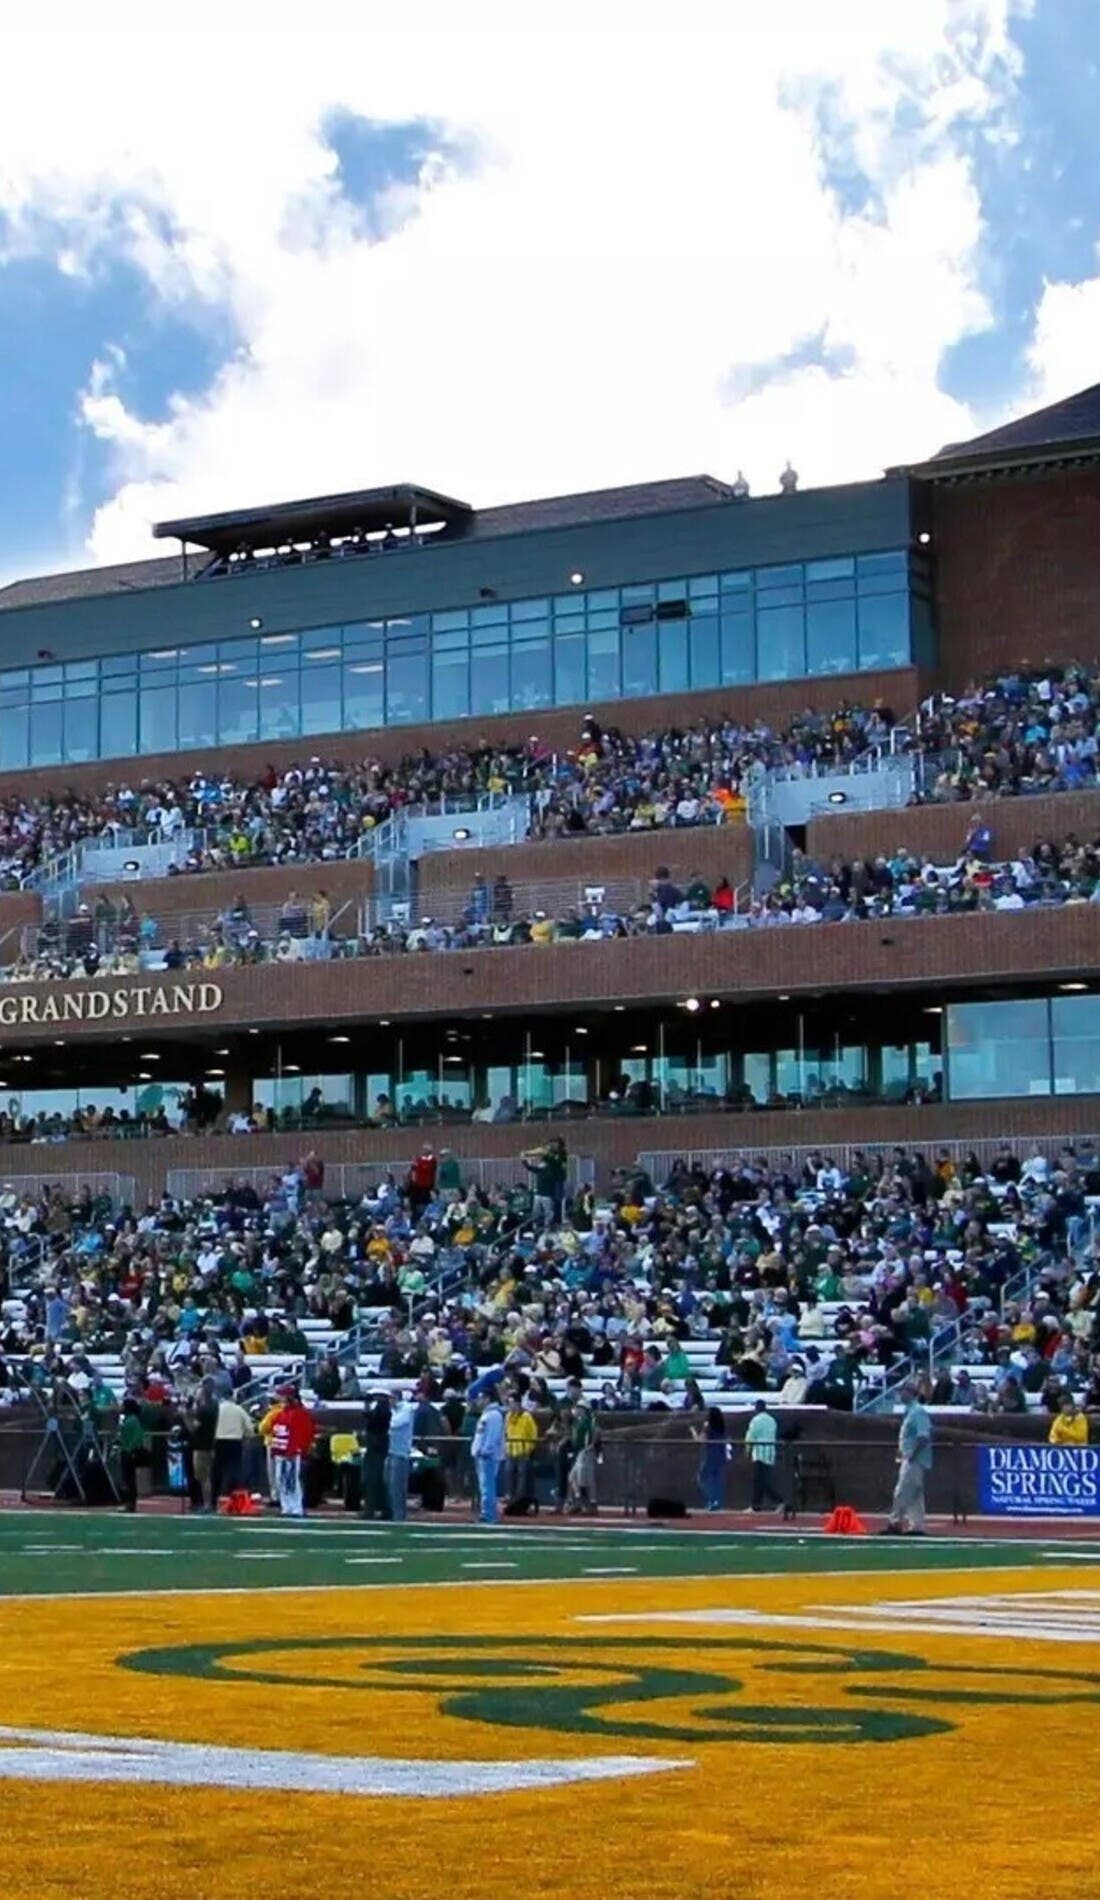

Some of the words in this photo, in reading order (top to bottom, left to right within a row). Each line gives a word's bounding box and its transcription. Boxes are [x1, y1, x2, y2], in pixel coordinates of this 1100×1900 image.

[0, 984, 222, 1024] GRANDSTAND
[989, 1448, 1098, 1471] DIAMOND
[991, 1471, 1097, 1496] SPRINGS
